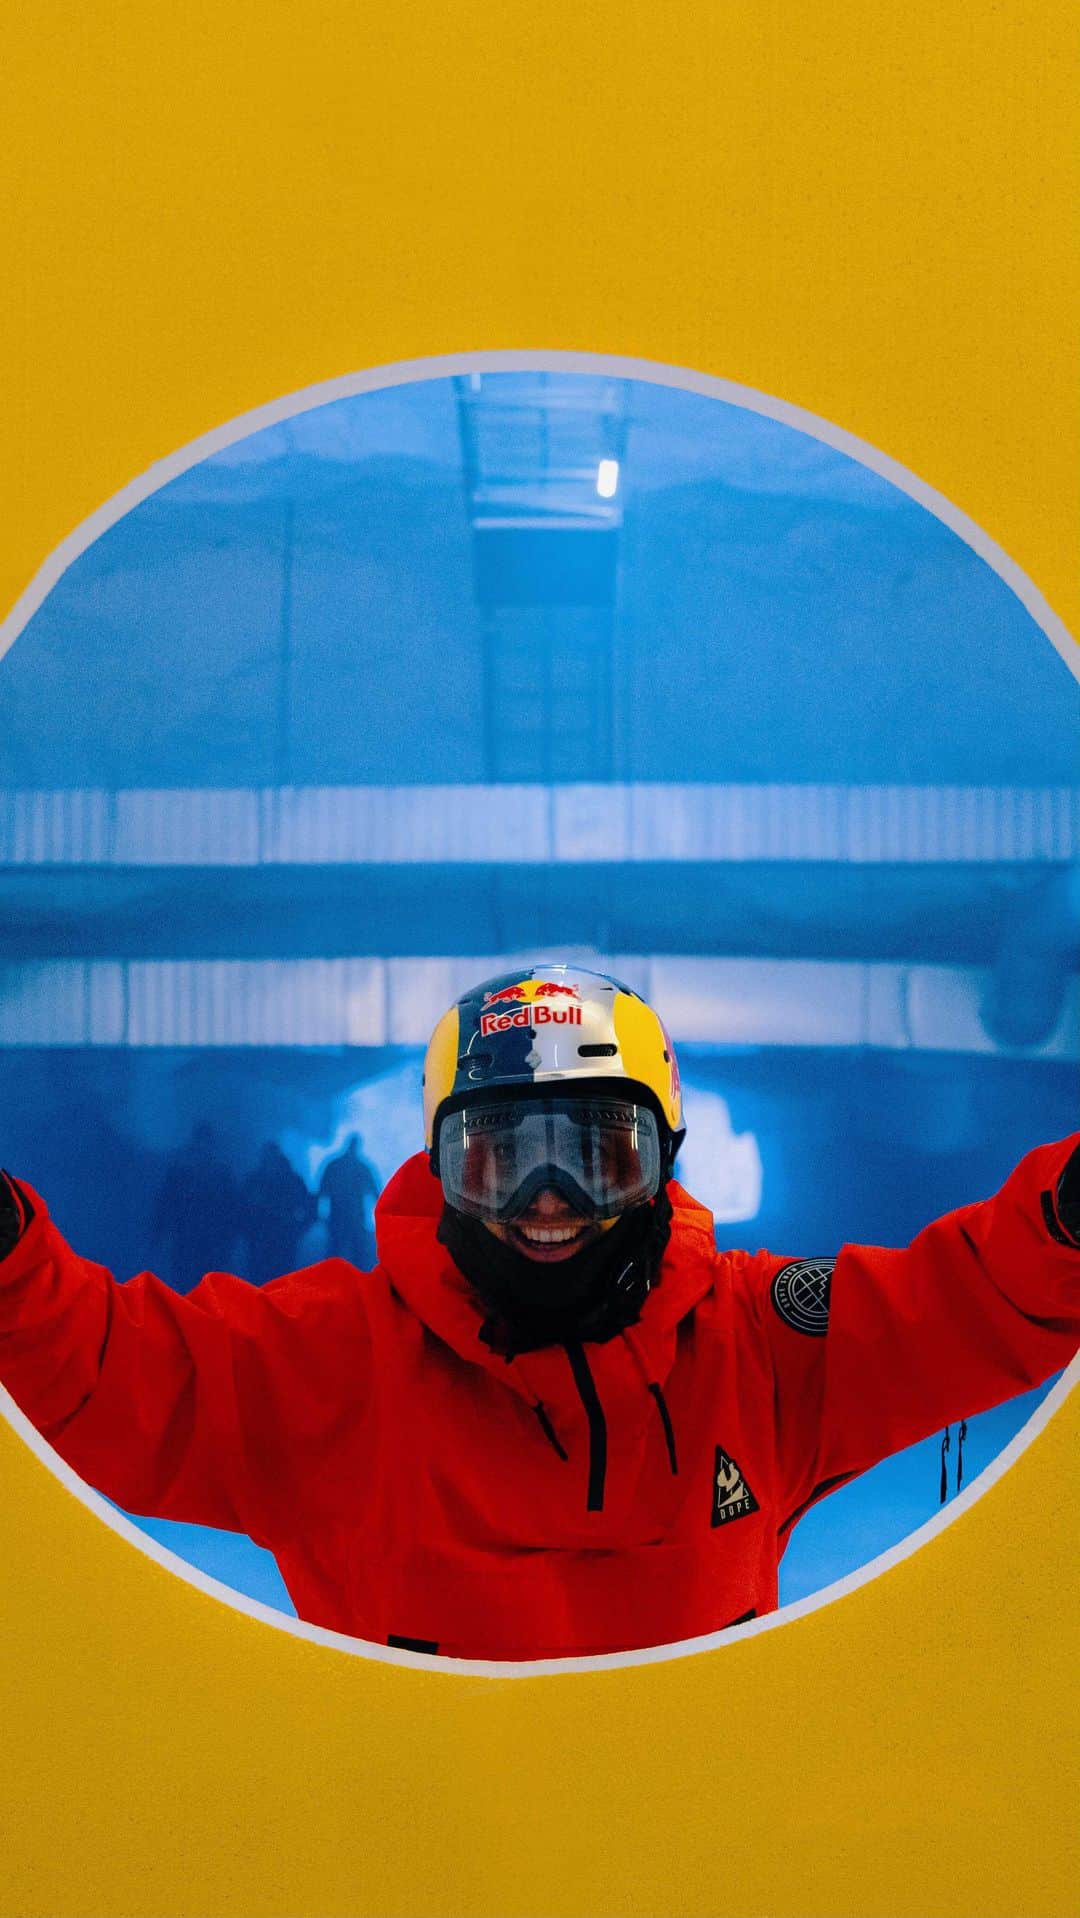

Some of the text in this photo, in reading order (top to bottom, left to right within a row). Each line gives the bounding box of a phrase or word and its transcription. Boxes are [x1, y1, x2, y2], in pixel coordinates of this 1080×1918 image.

[481, 1006, 582, 1036] Red Bull
[719, 1498, 750, 1520] DOPE
